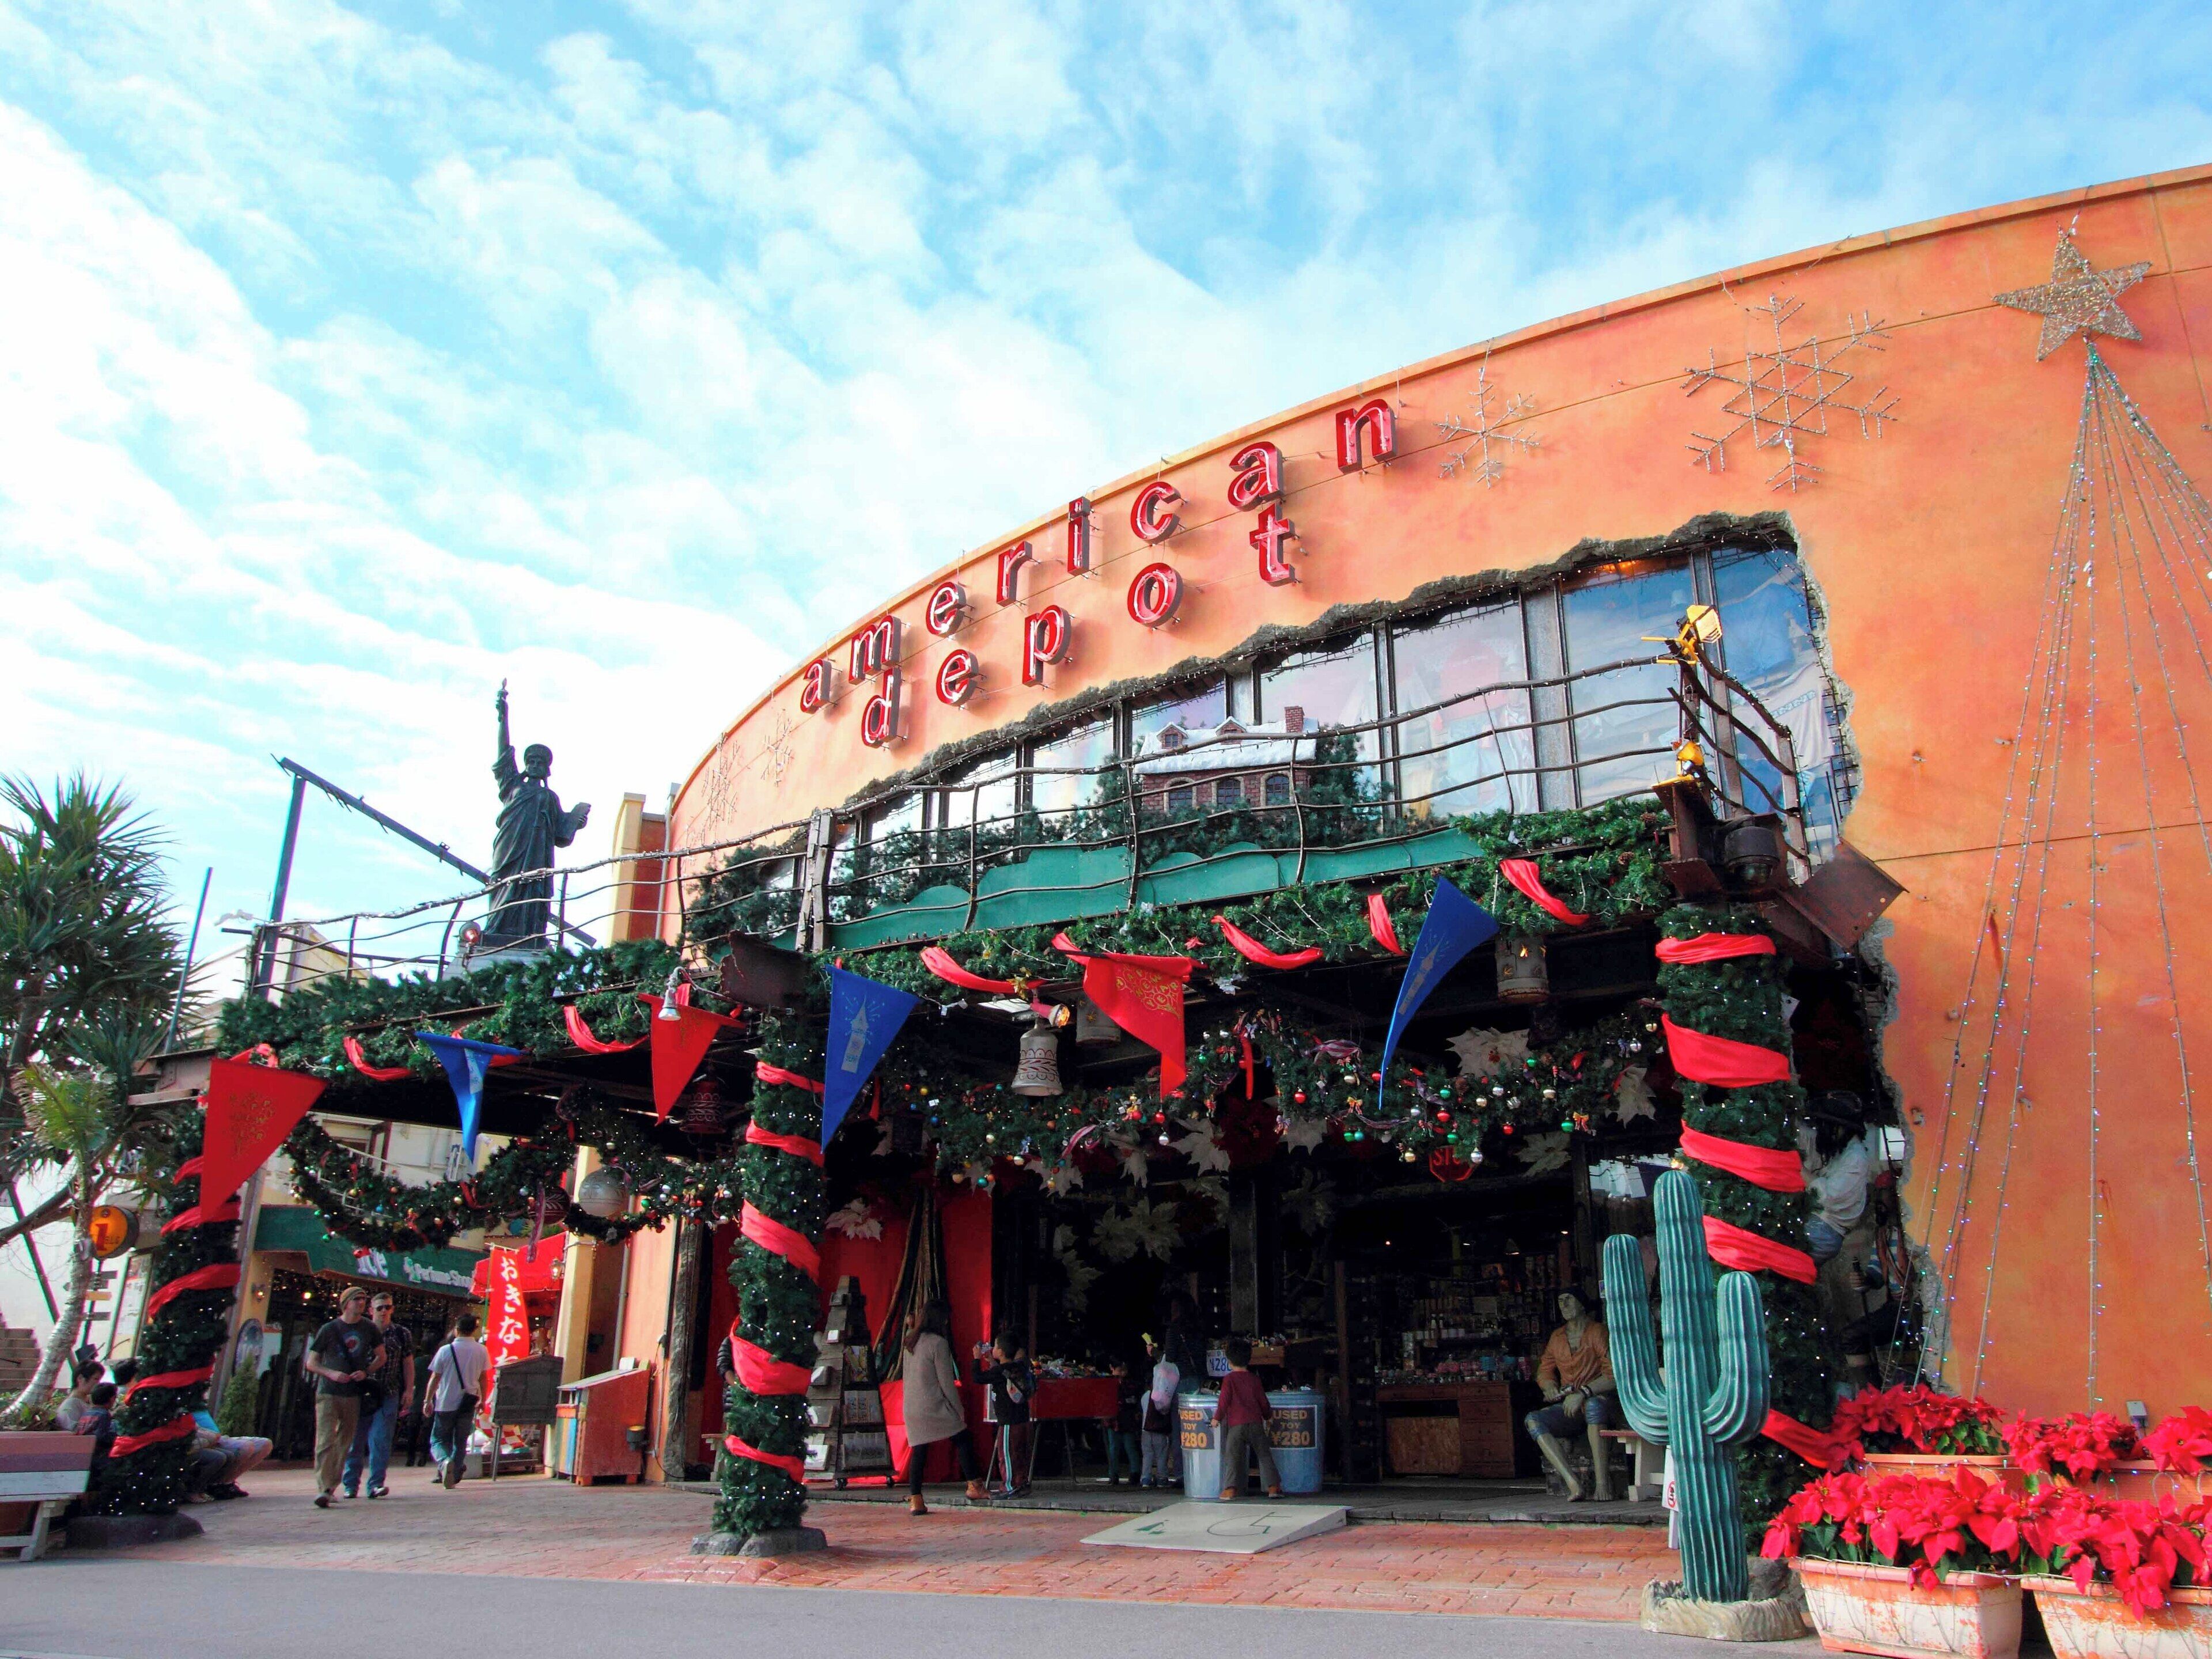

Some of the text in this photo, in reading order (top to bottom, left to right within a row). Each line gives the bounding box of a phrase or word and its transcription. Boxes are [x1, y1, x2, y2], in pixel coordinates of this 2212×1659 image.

[800, 399, 1397, 715] american
[861, 502, 1296, 749] depot
[1180, 1410, 1203, 1421] USED
[1272, 1410, 1308, 1420] USED
[1180, 1432, 1207, 1448] ¥280
[1271, 1431, 1310, 1446] ¥280
